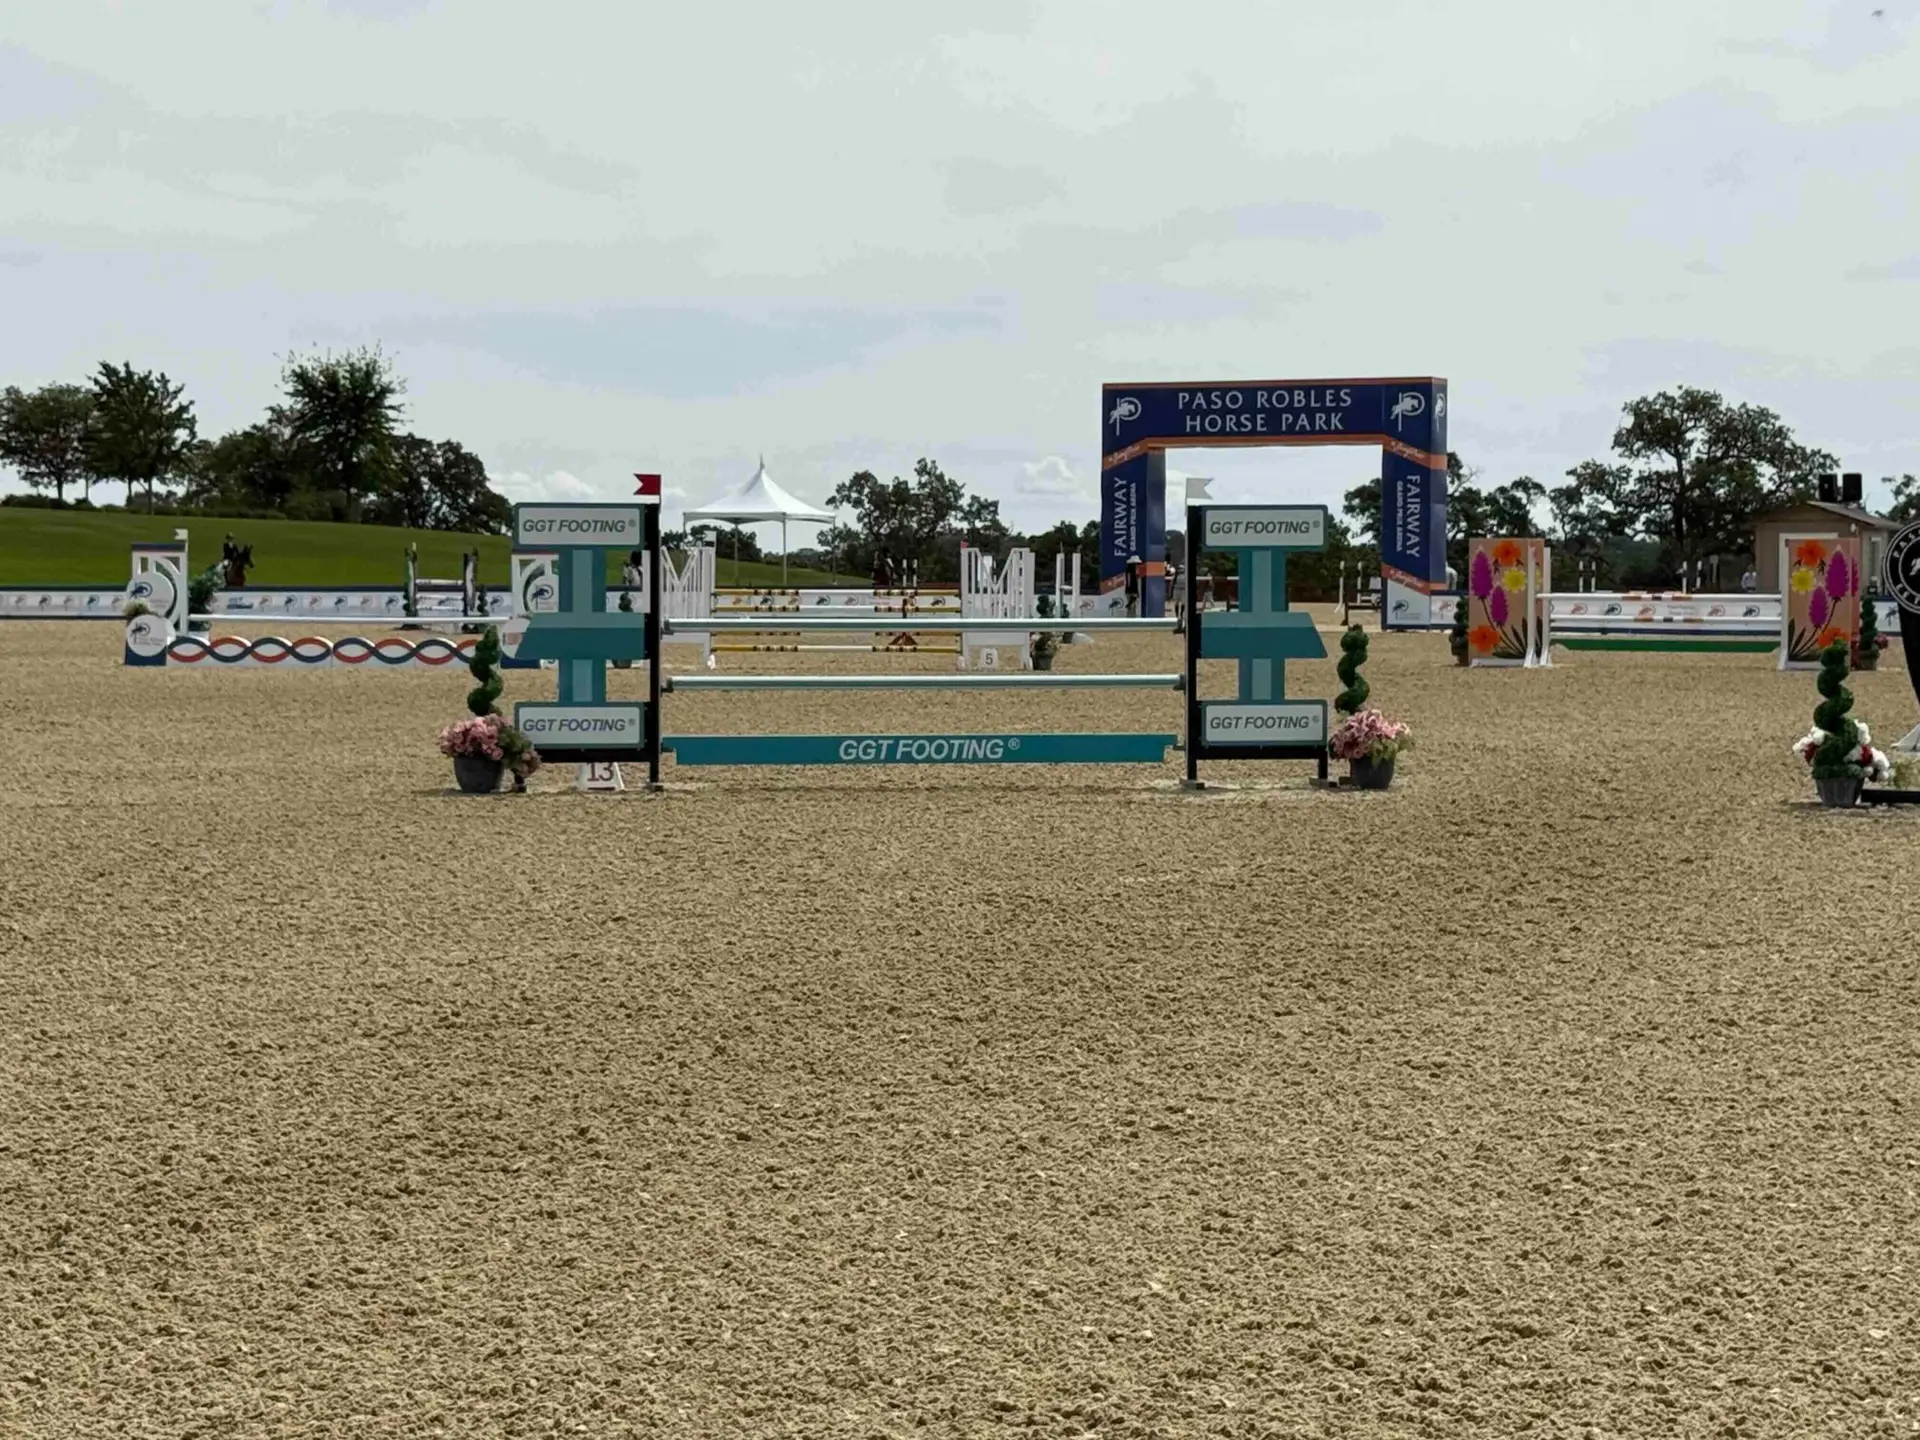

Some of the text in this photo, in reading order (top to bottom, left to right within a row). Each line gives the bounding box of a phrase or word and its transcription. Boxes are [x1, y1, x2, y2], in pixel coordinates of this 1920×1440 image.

[1178, 388, 1352, 410] PASO ROBLES
[1185, 411, 1345, 433] HORSE PARK
[522, 519, 556, 533] GGT
[1114, 476, 1128, 557] FAIRWAY
[1406, 474, 1421, 558] FAIRWAY
[1210, 521, 1243, 534] GGT
[984, 652, 994, 666] 5
[522, 718, 556, 732] GGT
[1210, 716, 1243, 729] GGT
[838, 739, 894, 761] GGT
[586, 762, 615, 782] 13
